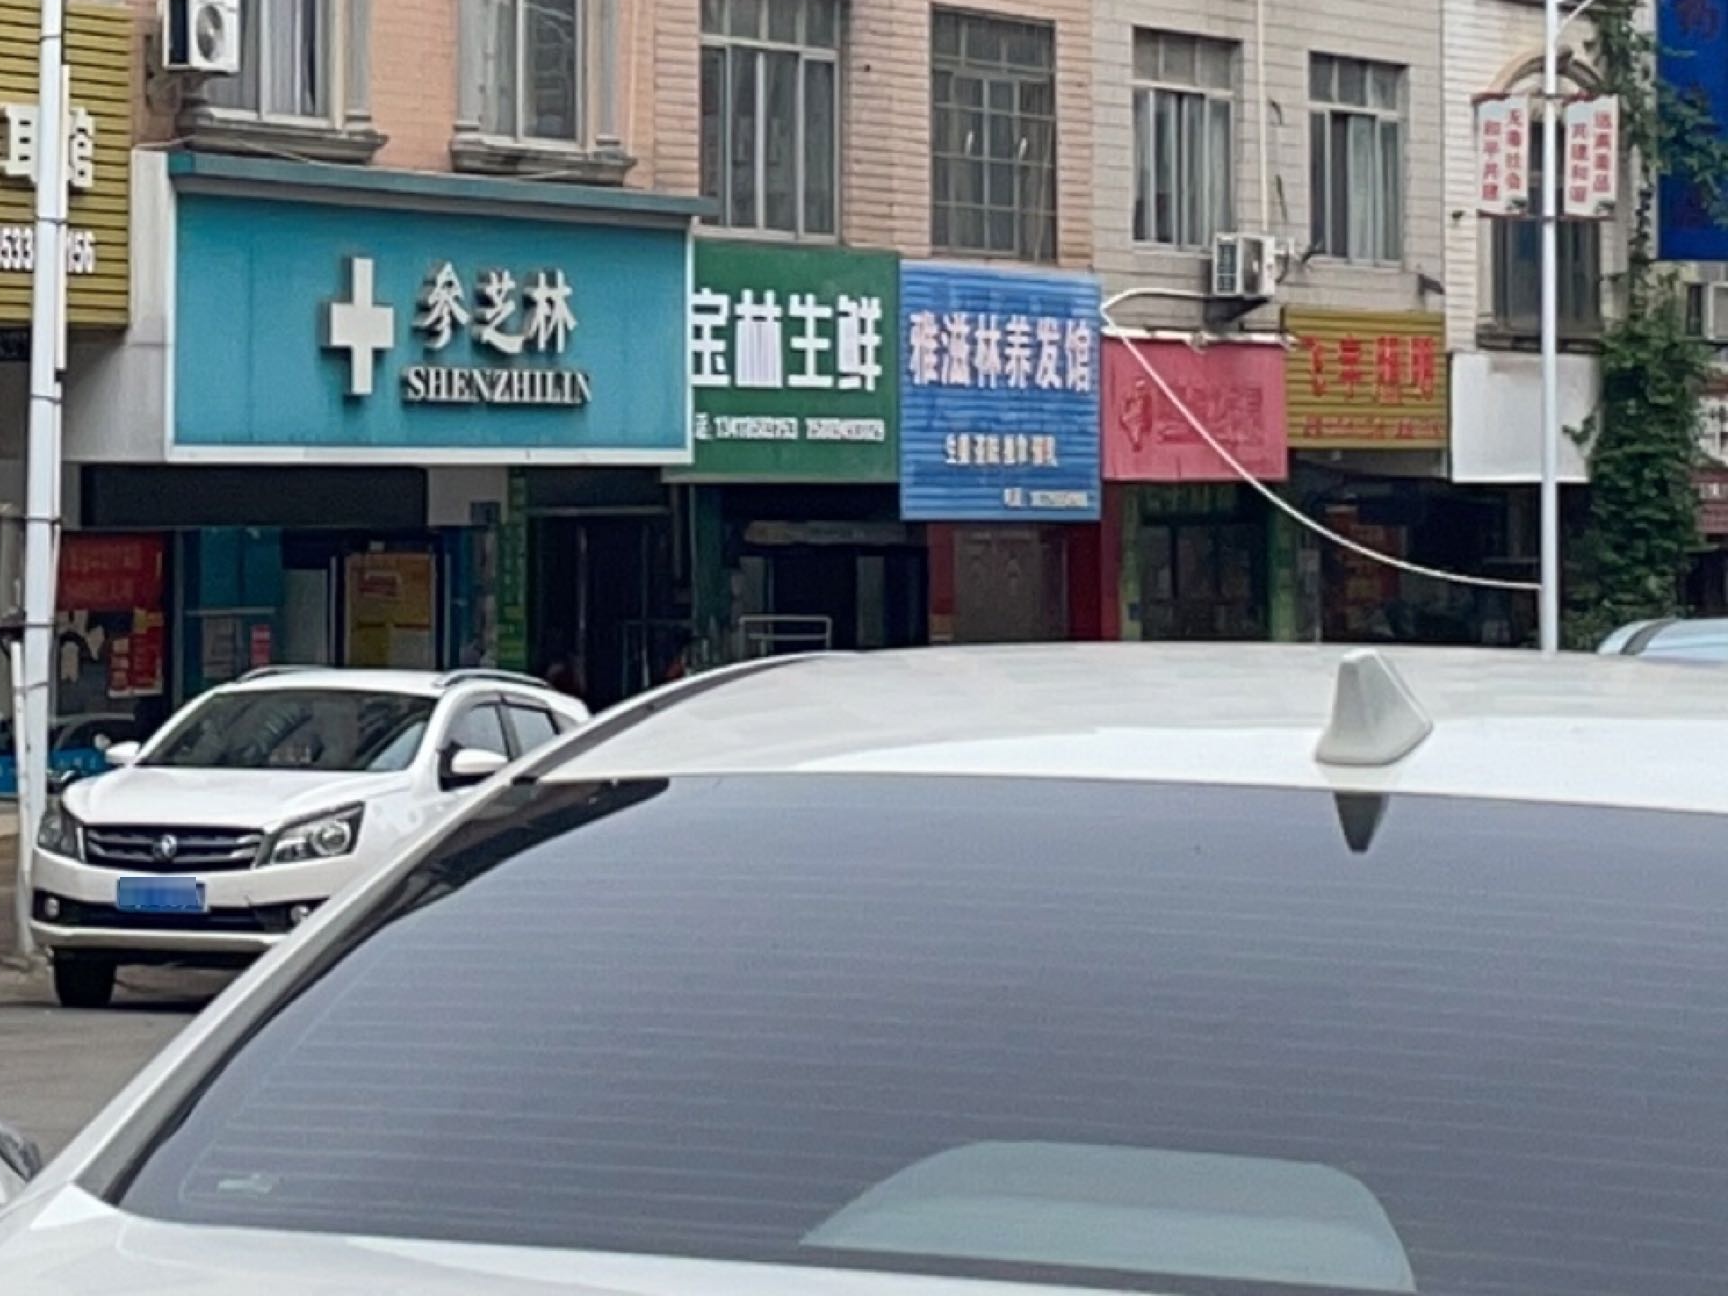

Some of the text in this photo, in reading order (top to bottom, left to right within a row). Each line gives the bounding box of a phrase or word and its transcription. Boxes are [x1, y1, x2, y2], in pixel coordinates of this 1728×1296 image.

[414, 260, 579, 354] 参芝林
[406, 366, 592, 405] SHENZHILIN
